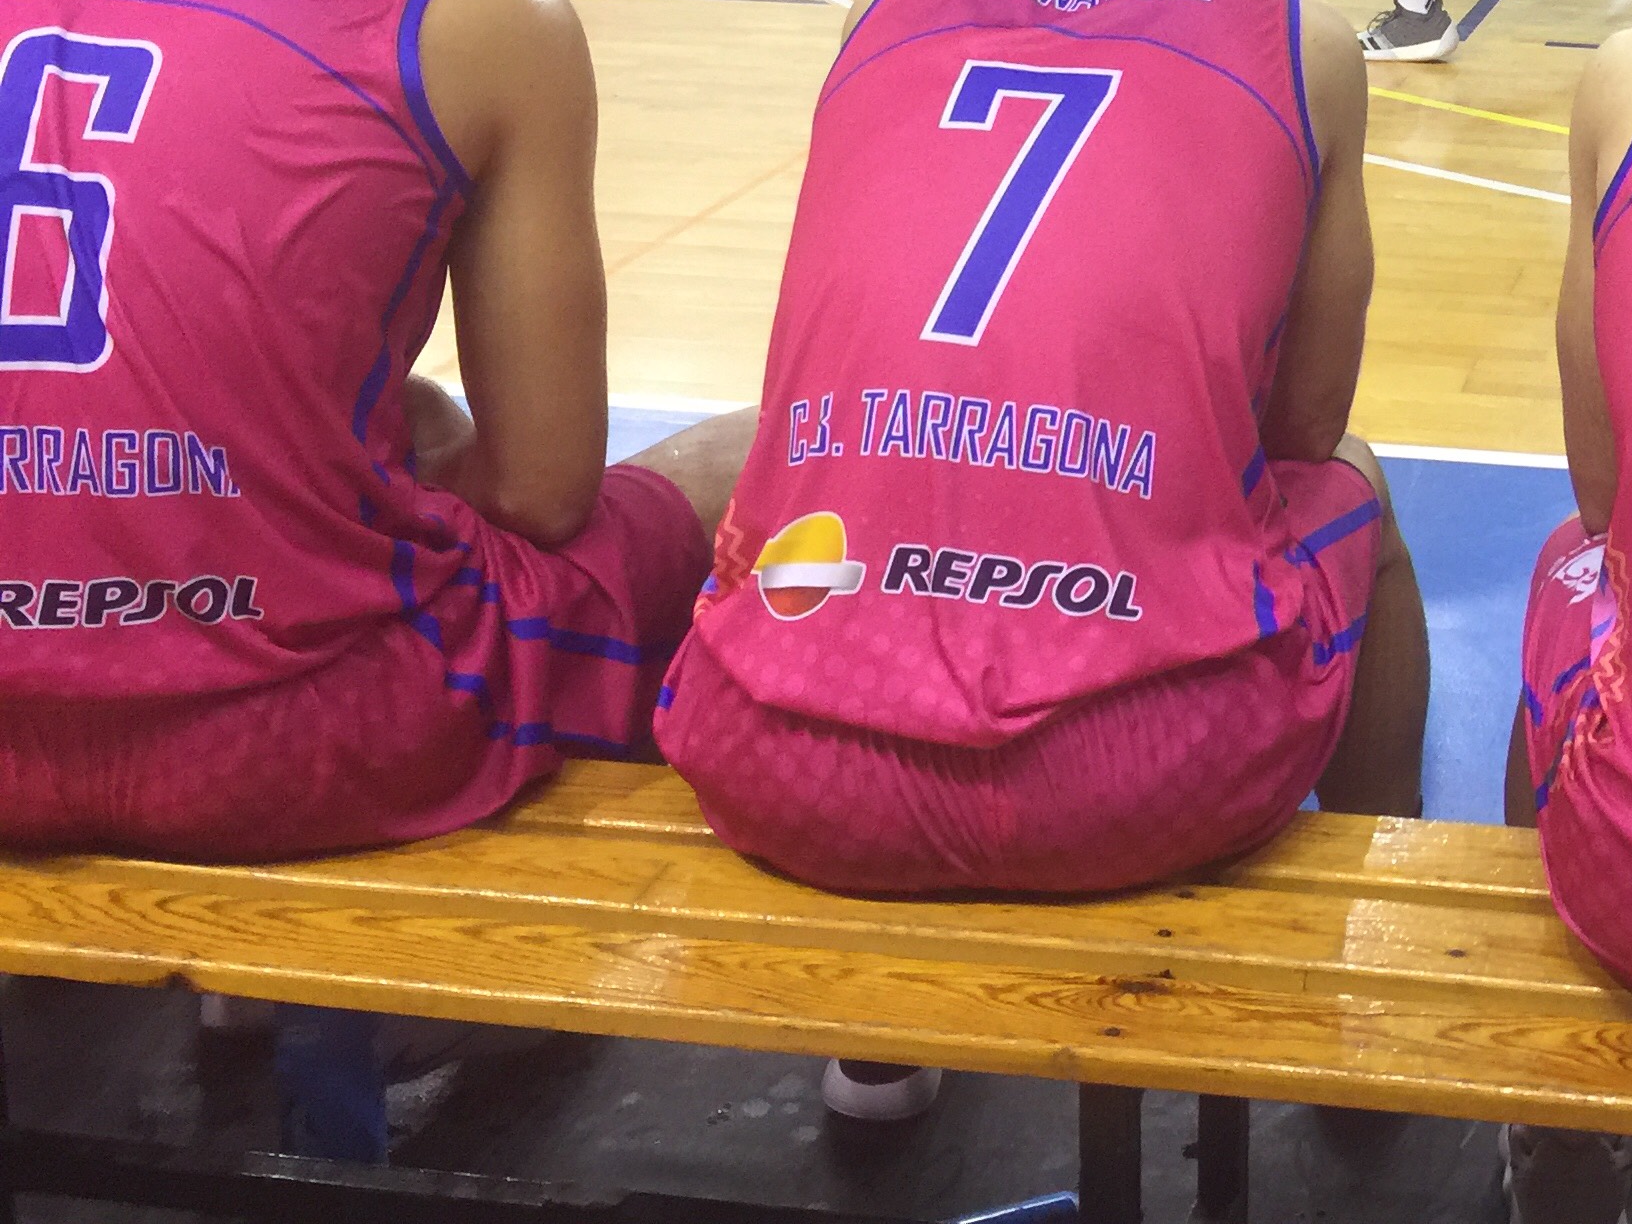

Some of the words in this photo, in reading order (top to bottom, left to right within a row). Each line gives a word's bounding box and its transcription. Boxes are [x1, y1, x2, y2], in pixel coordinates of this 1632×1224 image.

[0, 26, 163, 374] 6
[919, 58, 1123, 347] 7
[0, 425, 241, 498] RRAGON
[860, 388, 1156, 500] TARRAGONA
[0, 575, 264, 630] REPSOL
[880, 544, 1144, 622] REPSOL
